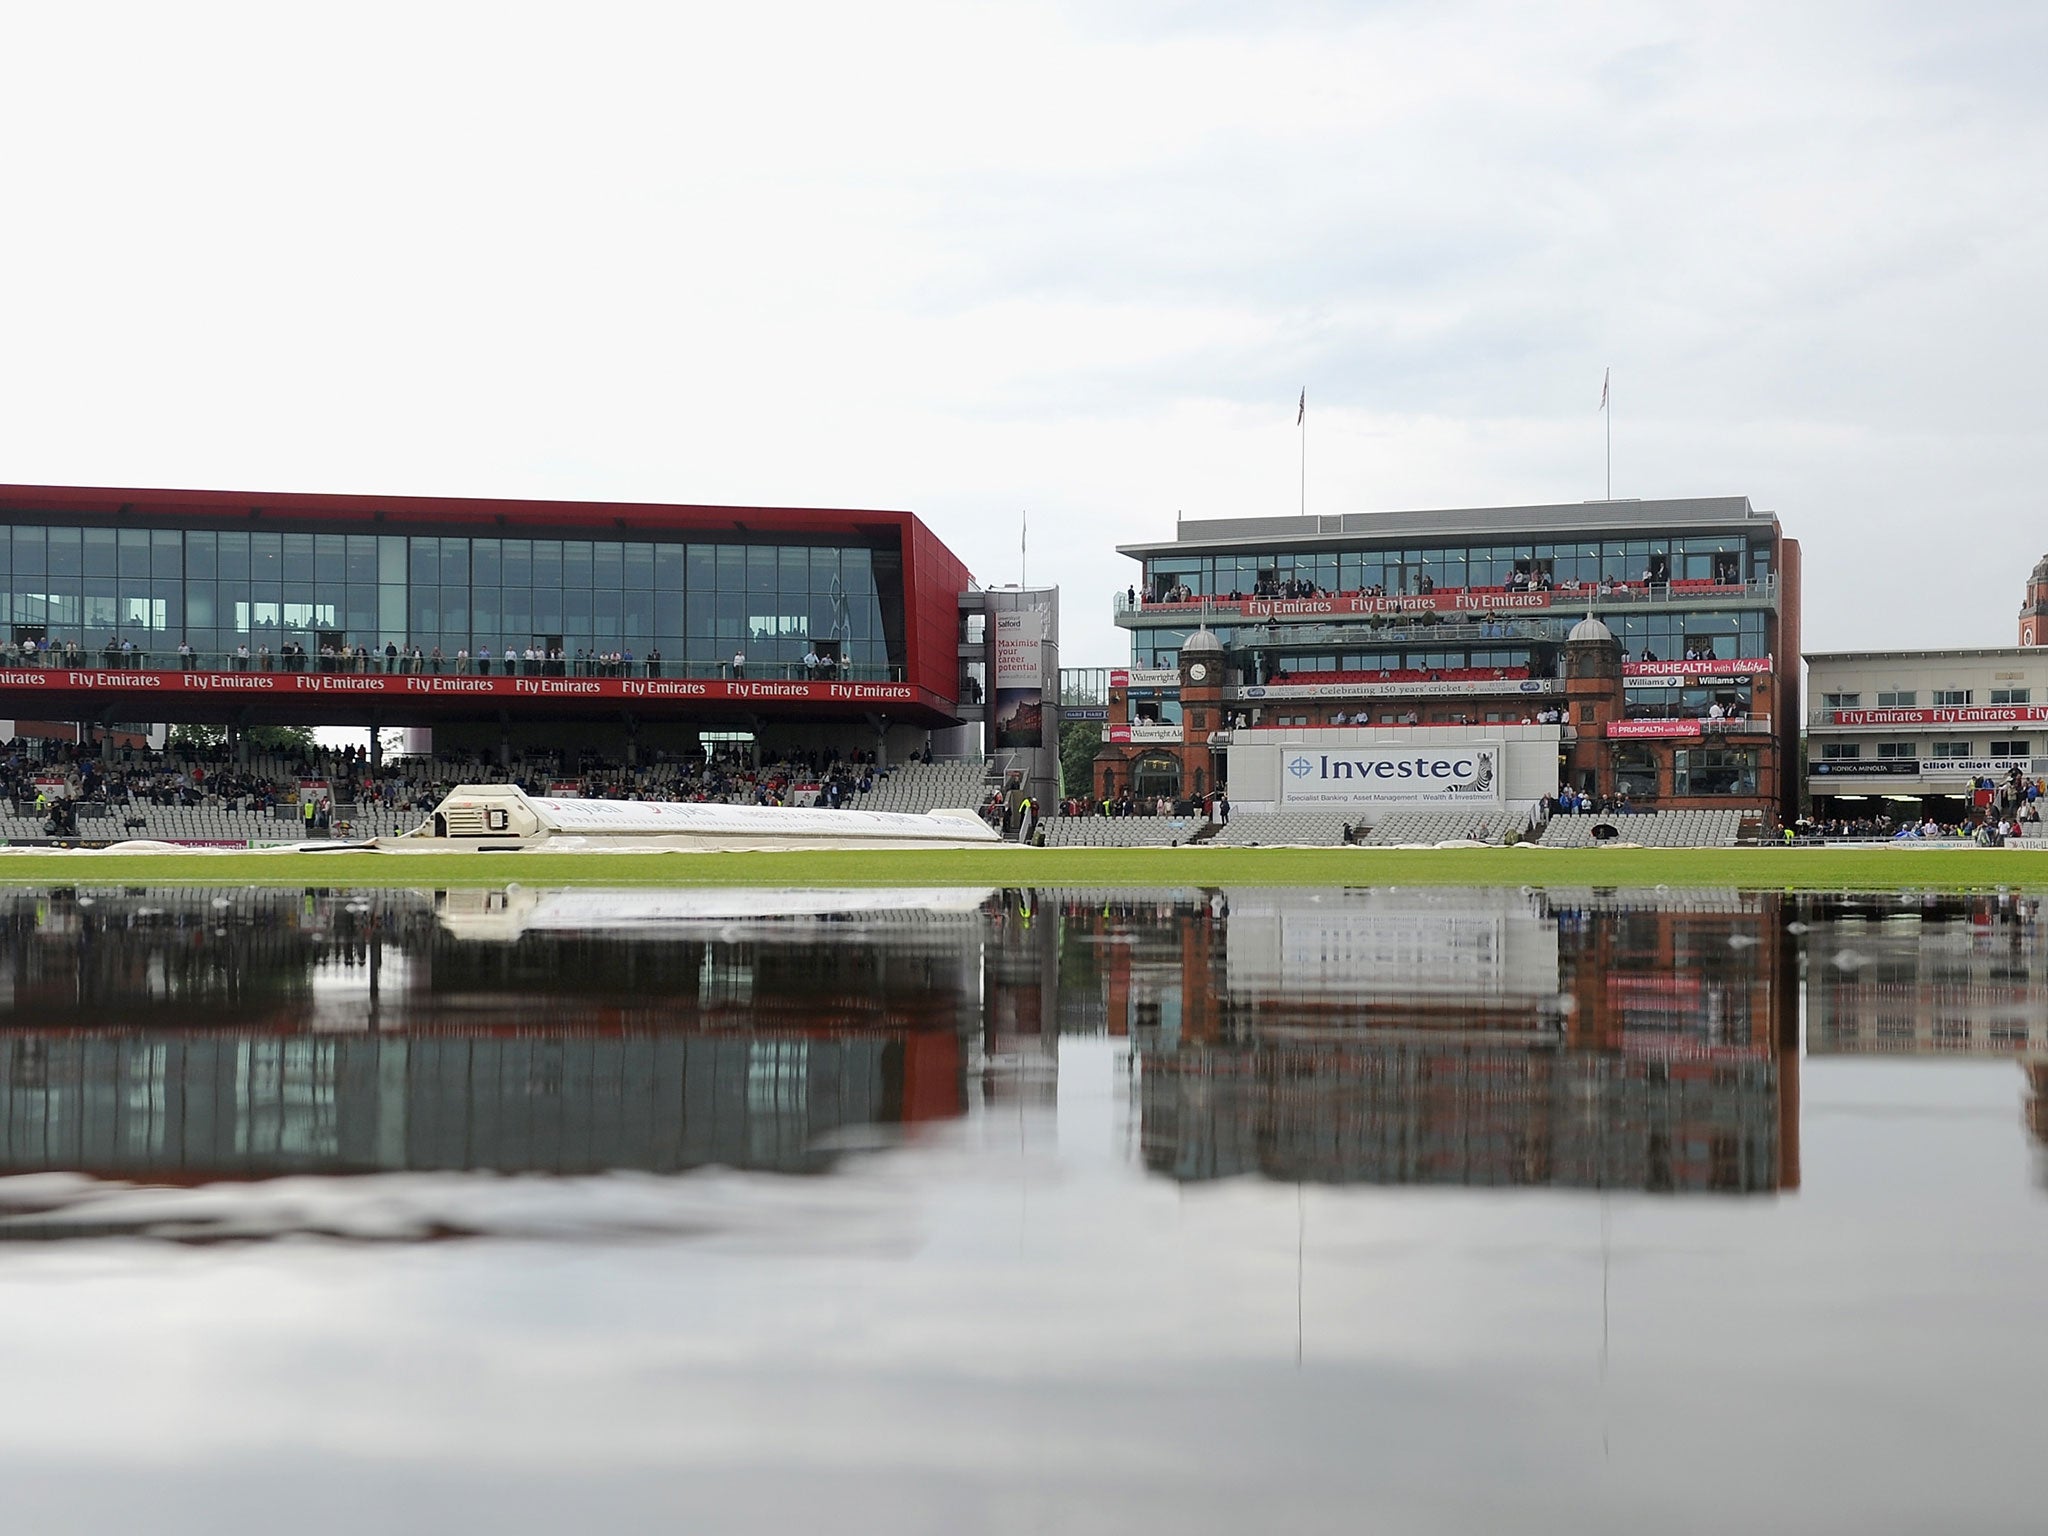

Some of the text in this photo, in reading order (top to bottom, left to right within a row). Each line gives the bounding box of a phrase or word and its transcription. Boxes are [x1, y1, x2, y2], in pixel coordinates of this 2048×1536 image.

[1249, 599, 1332, 616] Fly Emirates
[1351, 597, 1436, 613] Fly Emirates
[1455, 594, 1543, 609] Fly Emirates
[998, 649, 1018, 657] your
[998, 663, 1037, 672] potential
[1640, 663, 1712, 674] PRUHEALTH
[1733, 660, 1768, 674] Vitality
[70, 672, 160, 688] Fly Emirates
[184, 674, 274, 690] Fly Emirates
[296, 676, 385, 691] Fly Emirates
[407, 678, 494, 693] Fly Emirates
[1132, 673, 1174, 683] Wainwright
[1629, 678, 1665, 686] Williams
[1699, 676, 1735, 685] Williams
[516, 679, 600, 694] Fly Emirates
[622, 681, 706, 696] Fly Emirates
[727, 683, 809, 697] Fly Emirates
[830, 684, 911, 699] Fly Emirates
[1320, 684, 1462, 695] Celebrating 150 years' cricket
[1842, 709, 1923, 725] Fly Emirates
[1933, 707, 2016, 723] Fly Emirates
[2027, 707, 2048, 721] Fly
[1132, 730, 1171, 739] Wainwright
[1320, 755, 1472, 779] Investec
[1287, 794, 1319, 802] Specialist
[1321, 794, 1348, 802] Banking
[1373, 794, 1418, 802] Management
[1988, 793, 1993, 803] 1
